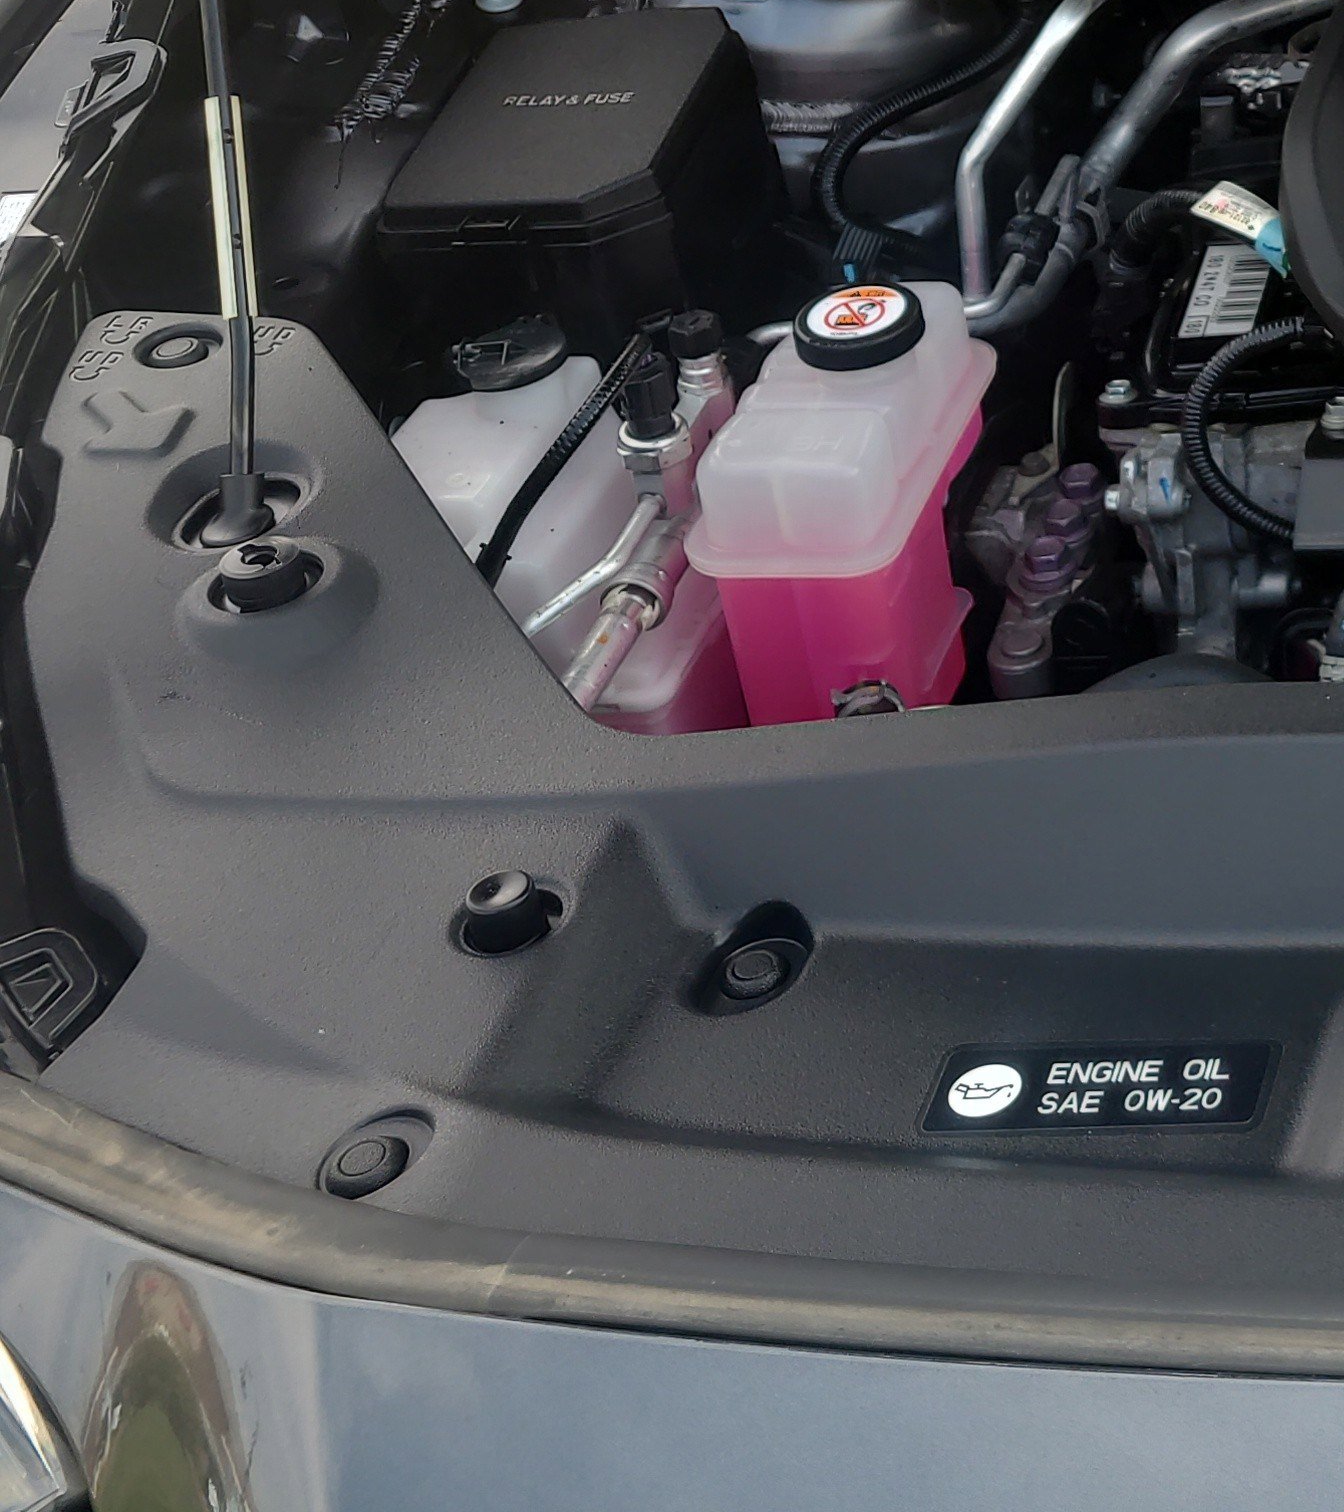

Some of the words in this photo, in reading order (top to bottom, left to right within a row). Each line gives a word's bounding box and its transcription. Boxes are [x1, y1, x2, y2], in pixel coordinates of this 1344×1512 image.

[502, 94, 566, 107] RELAY
[583, 91, 635, 106] FUSE
[78, 350, 125, 366] UP
[1046, 1059, 1164, 1085] ENGINE
[1183, 1057, 1230, 1081] OIL
[1037, 1090, 1105, 1115] SAE
[1124, 1087, 1223, 1113] 0W-20
